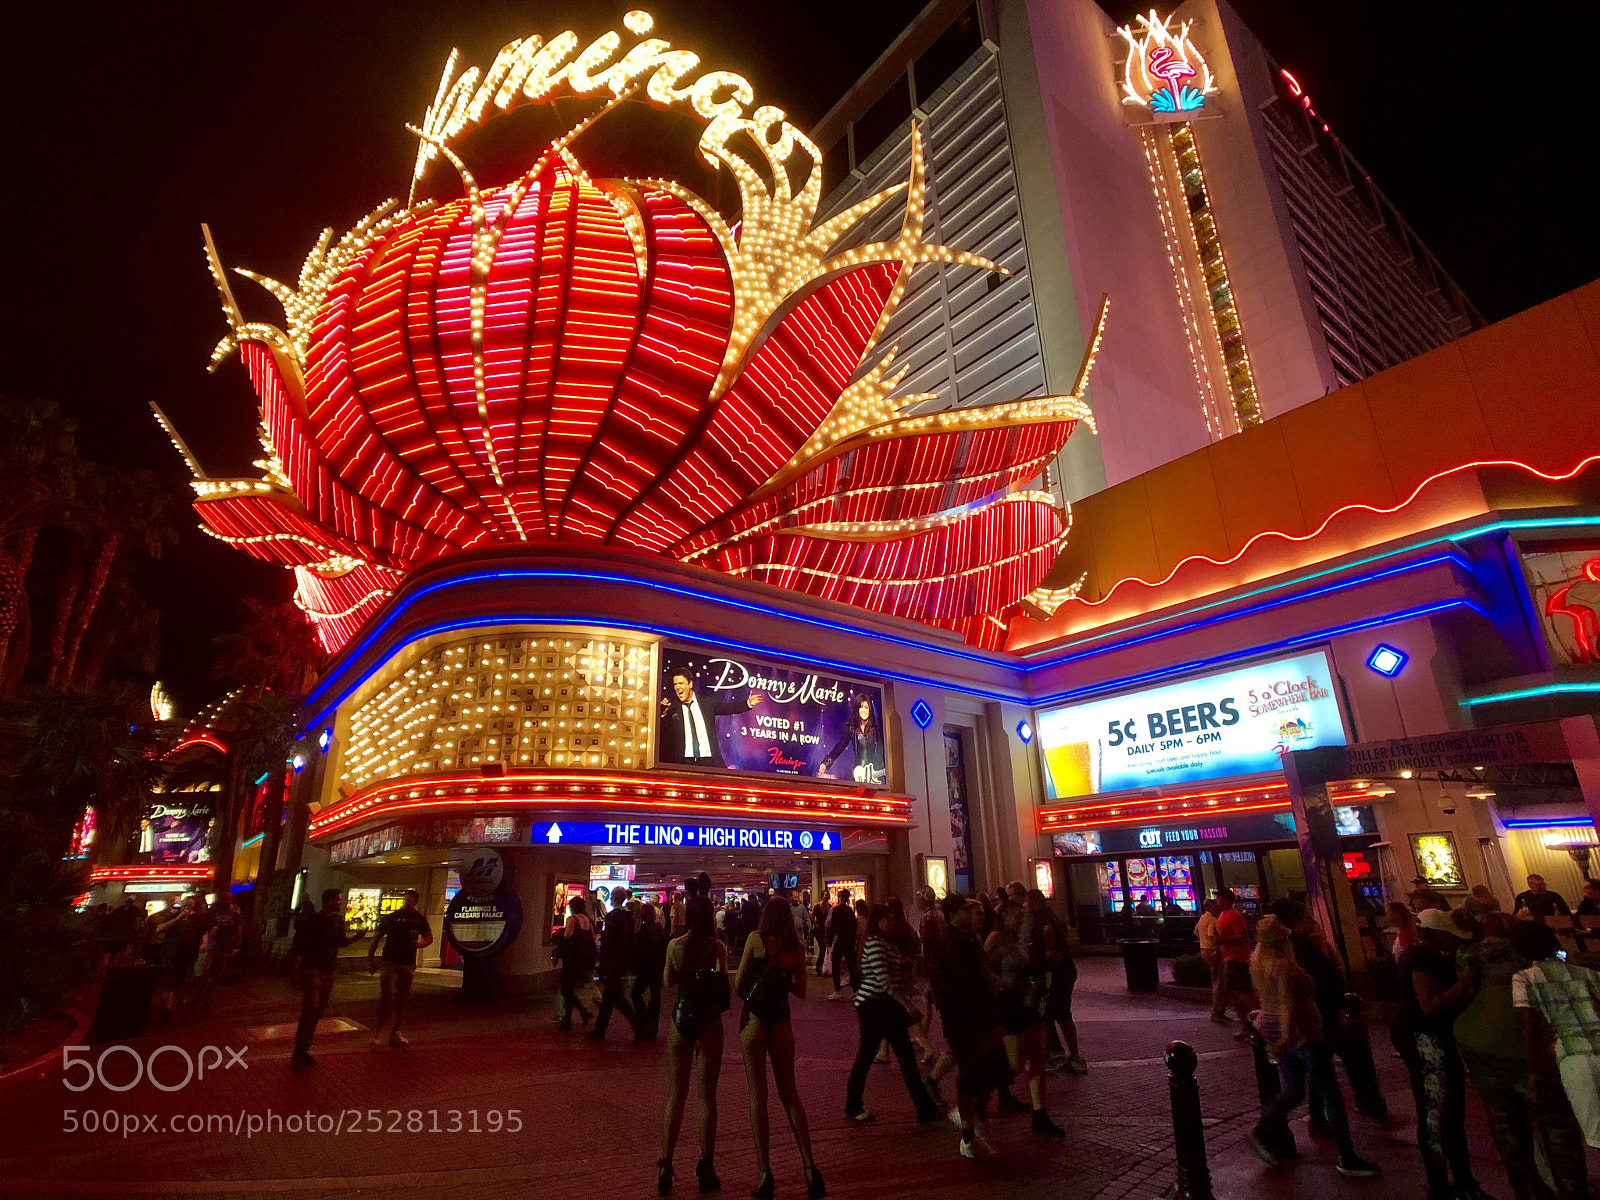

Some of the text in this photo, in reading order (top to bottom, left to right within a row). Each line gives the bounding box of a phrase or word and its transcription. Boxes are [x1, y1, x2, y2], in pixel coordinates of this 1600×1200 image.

[706, 658, 844, 705] Donny & Marie
[1248, 689, 1258, 705] 5
[1308, 687, 1328, 701] BAR
[755, 714, 805, 732] VOTED #1
[1108, 697, 1240, 746] 5¢ BEERS
[741, 726, 820, 745] 3 YEARS IN A ROW
[1127, 743, 1155, 756] DAILY
[1160, 738, 1184, 751] 5PM
[1196, 732, 1222, 745] 6PM
[1351, 747, 1389, 762] MILLER
[1421, 740, 1463, 755] COORS
[1465, 733, 1501, 750] LIGHT
[1506, 731, 1525, 745] OR
[767, 747, 806, 769] Flamingo
[1350, 761, 1387, 776] COORS
[1388, 754, 1443, 772] BANQUET
[1447, 750, 1499, 766] STARTING
[1502, 748, 1515, 760] AT
[605, 823, 794, 848] THE LINQ HIGH ROLLER
[1139, 829, 1161, 846] CUT
[1164, 831, 1180, 842] FEED
[1181, 829, 1199, 841] YOUR
[1199, 827, 1228, 840] PASSION
